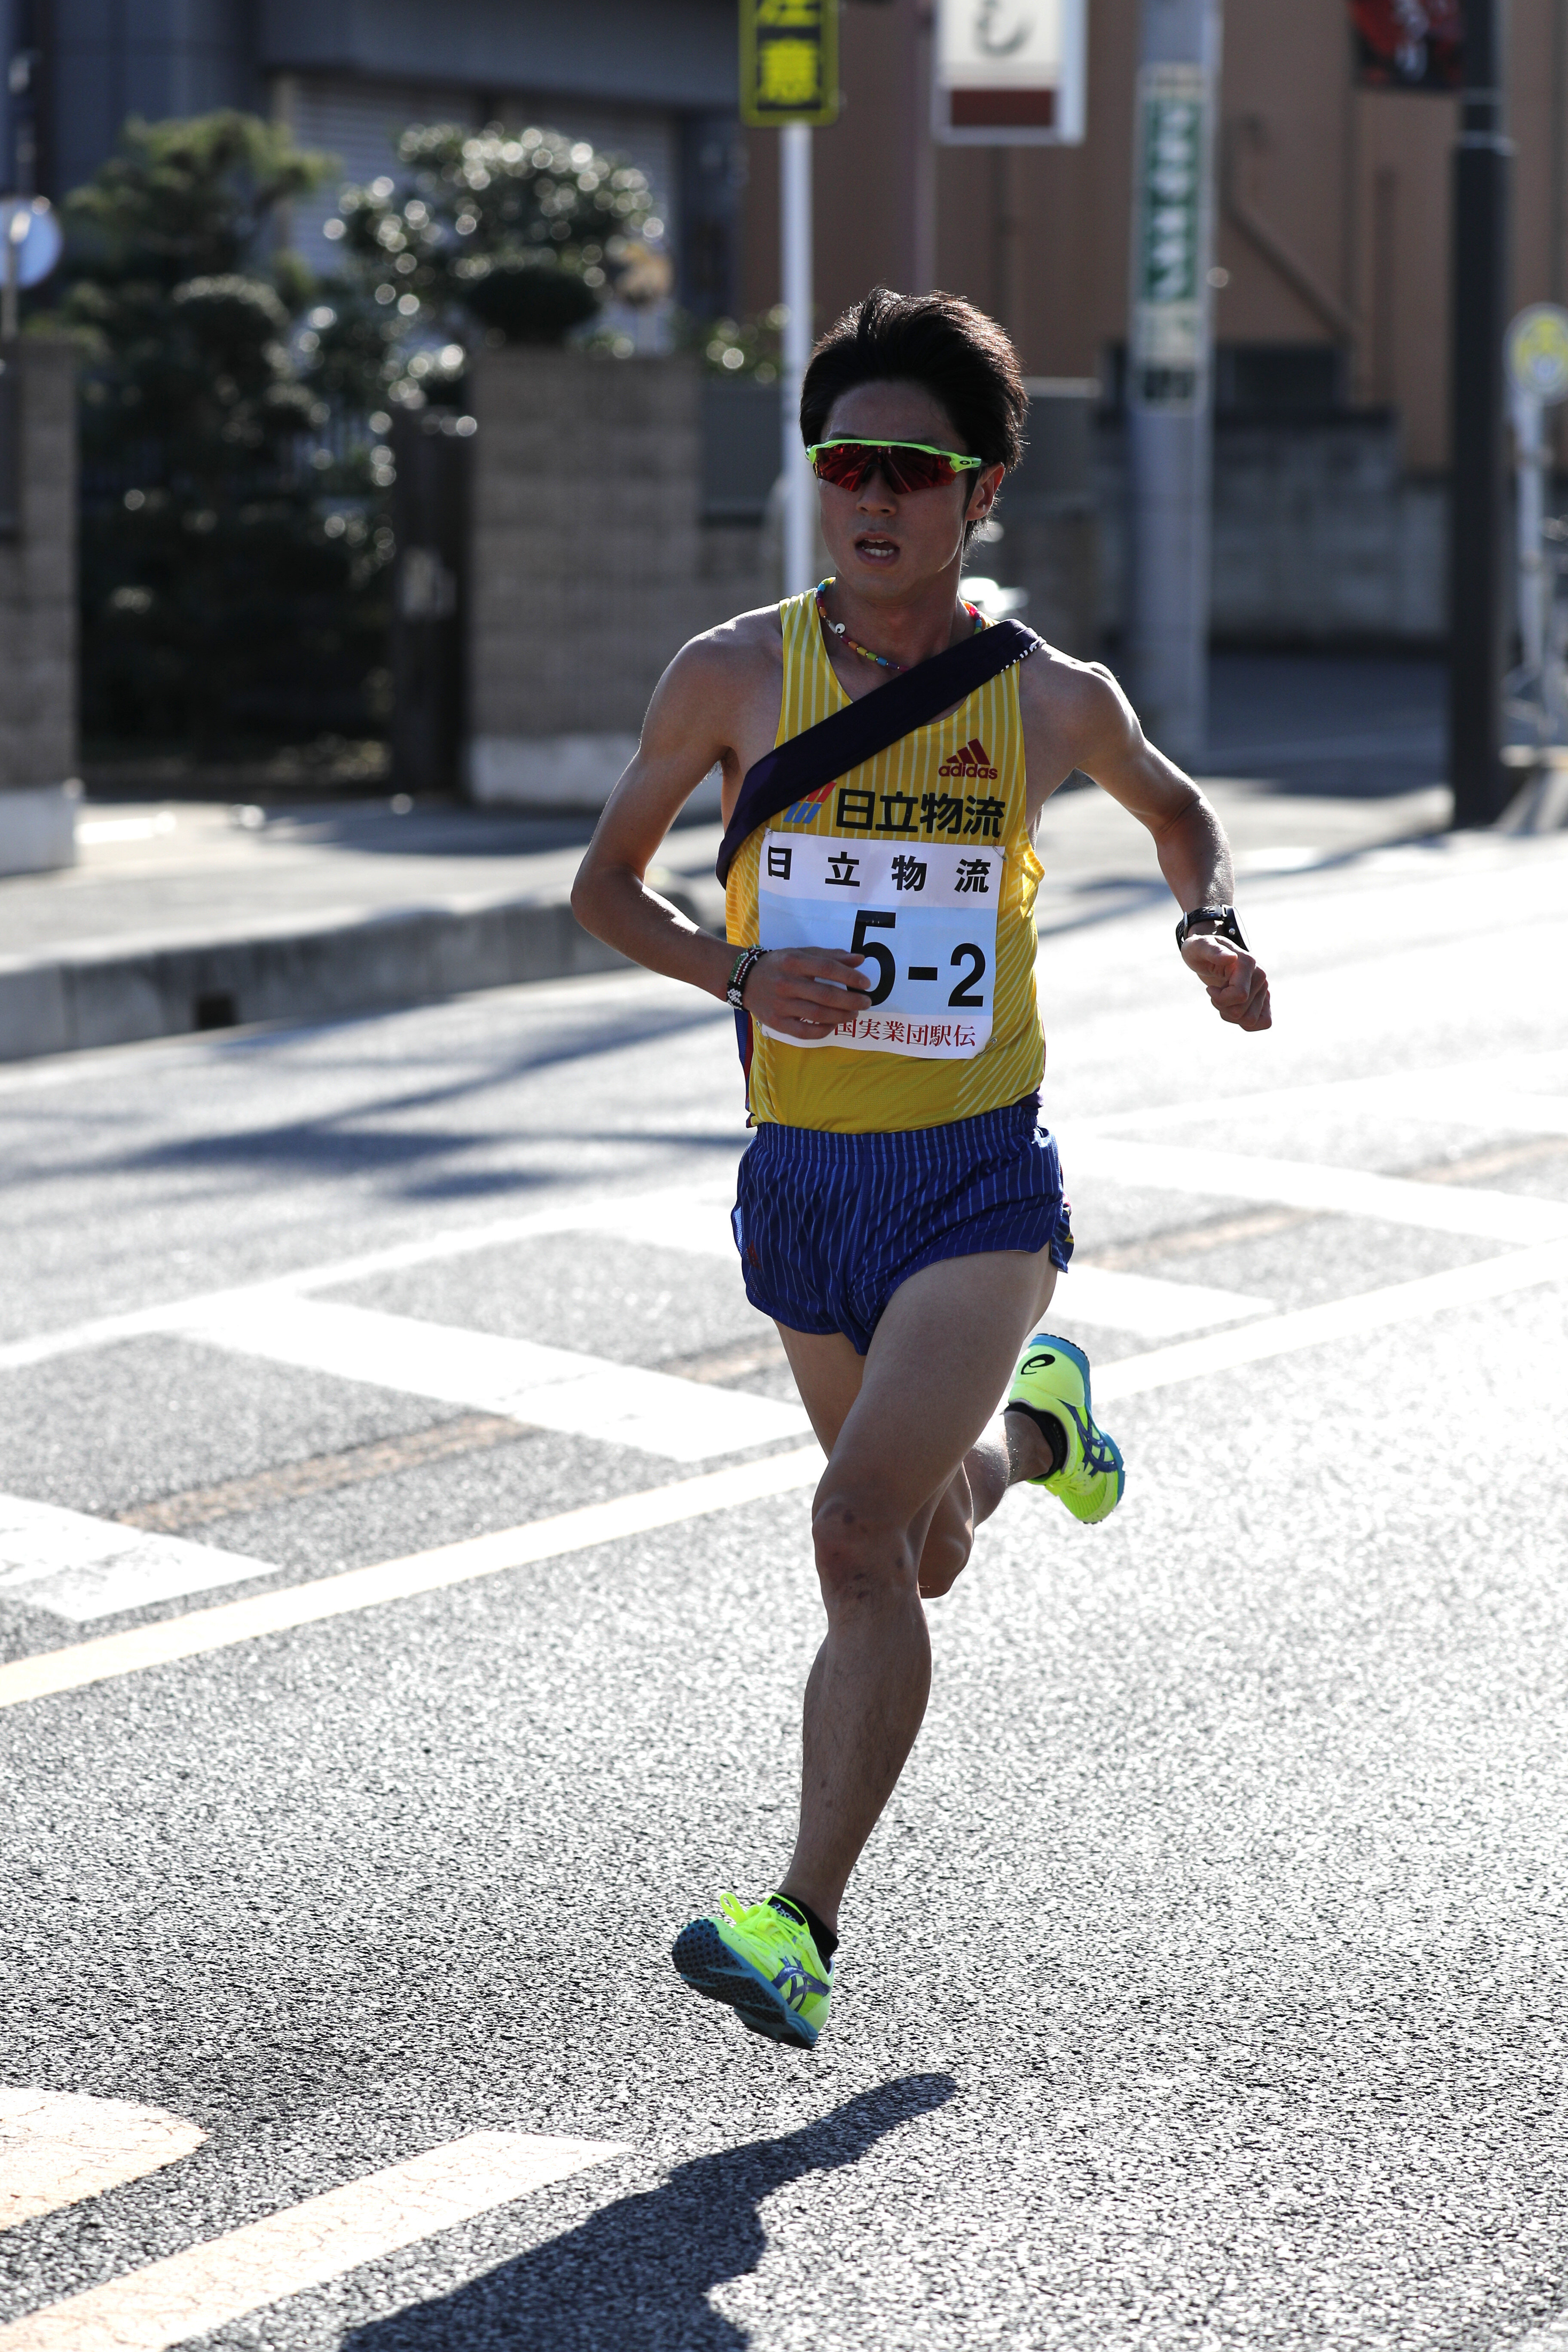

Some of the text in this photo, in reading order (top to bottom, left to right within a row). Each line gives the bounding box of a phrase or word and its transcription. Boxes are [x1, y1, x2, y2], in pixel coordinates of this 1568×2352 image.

[938, 762, 998, 780] adidas
[836, 788, 1005, 838] 日立物流
[767, 845, 991, 893] 日立物流
[847, 910, 986, 1008] 5-2
